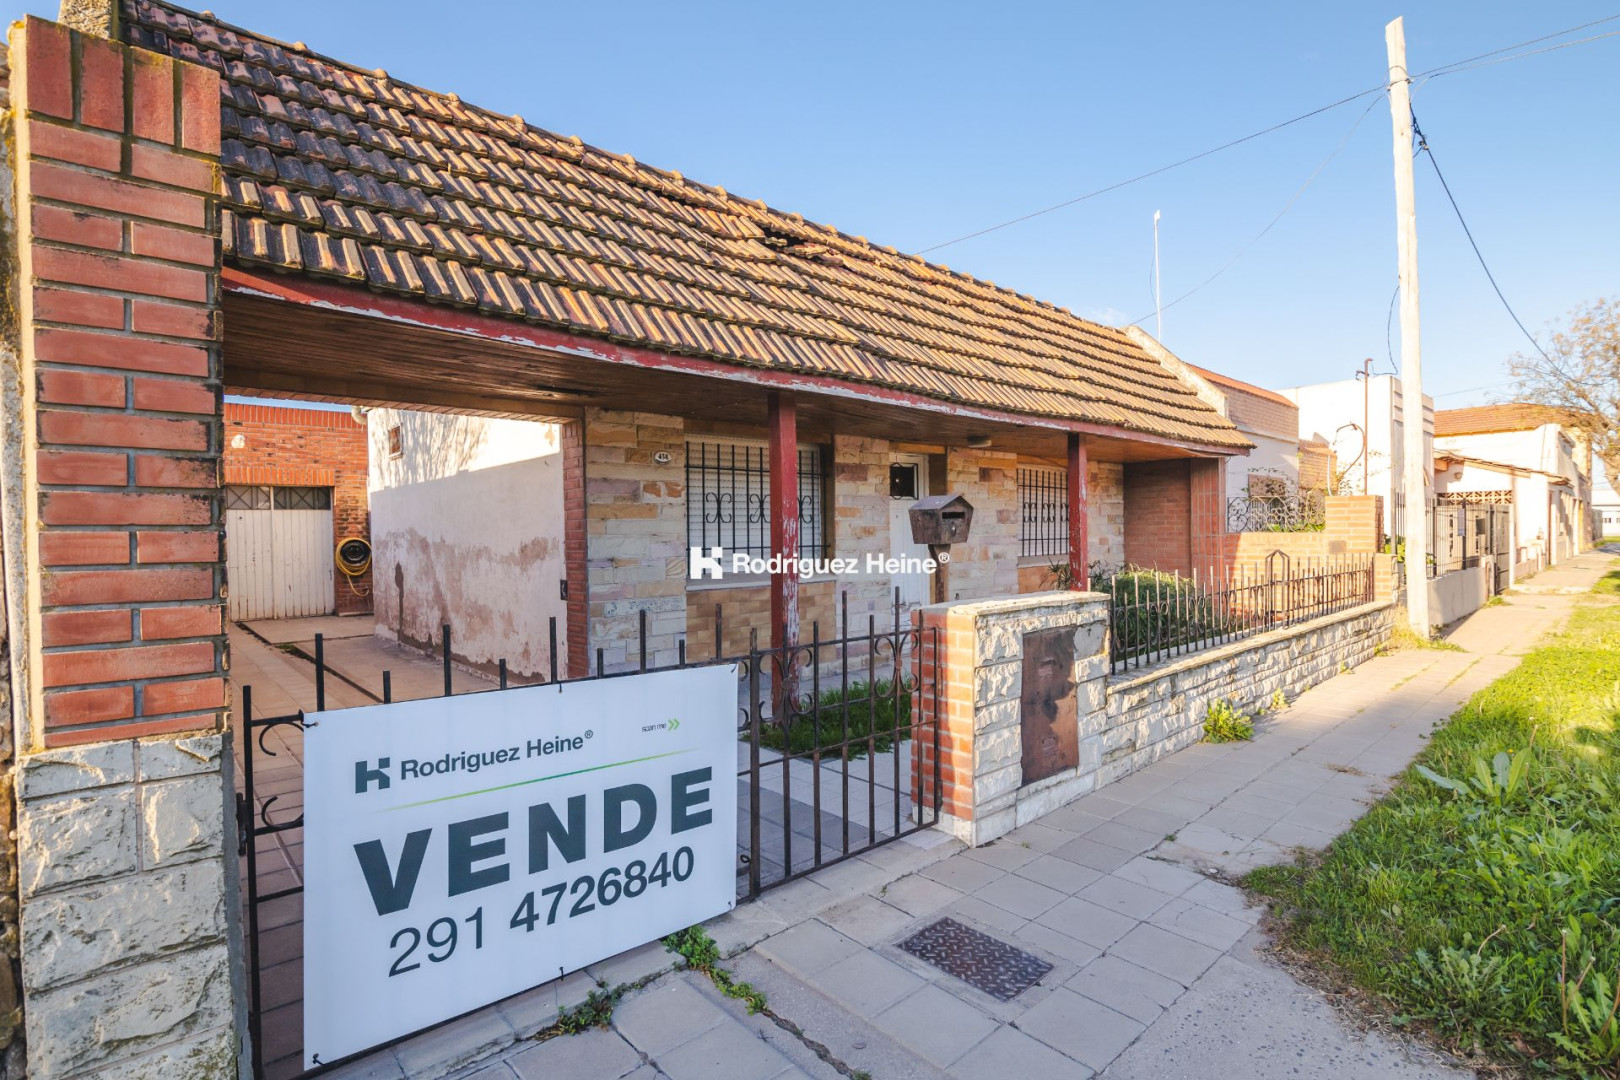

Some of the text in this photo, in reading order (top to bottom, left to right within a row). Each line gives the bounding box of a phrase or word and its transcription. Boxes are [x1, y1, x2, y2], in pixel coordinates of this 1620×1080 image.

[400, 747, 520, 781] Rodriguez
[641, 724, 657, 733] scan
[352, 765, 713, 917] VENDE
[388, 845, 695, 978] 291 4726840
